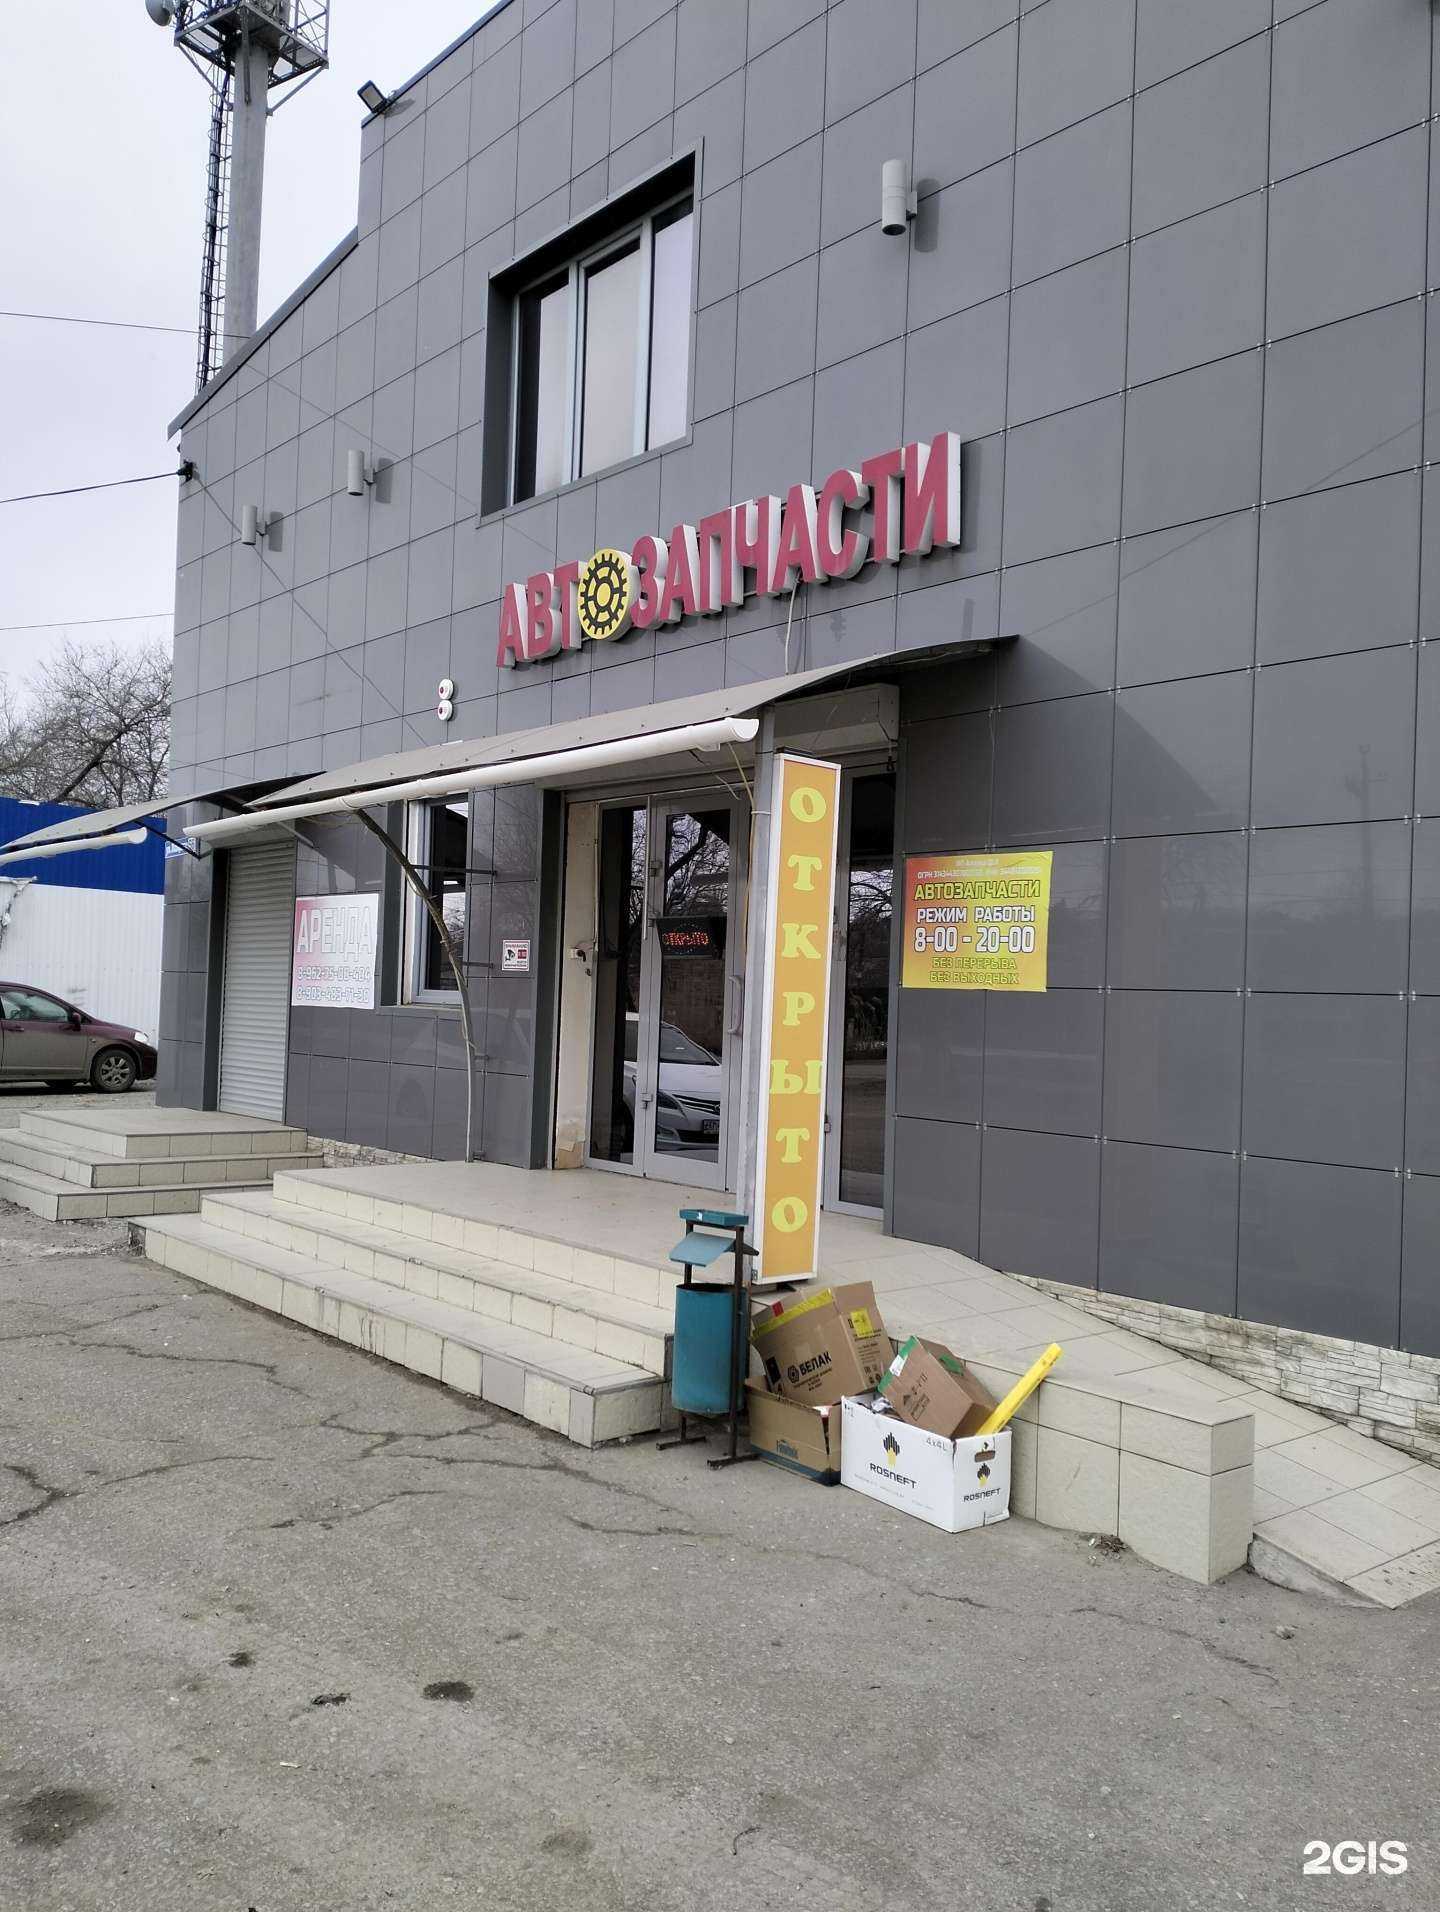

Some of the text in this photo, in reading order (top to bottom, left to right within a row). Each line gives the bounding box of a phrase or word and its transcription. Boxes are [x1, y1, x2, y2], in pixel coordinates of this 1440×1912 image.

[497, 432, 961, 668] АВТОЗАПЧАСТИ
[914, 879, 1041, 900] АВТОЗАПЧАСТИ
[916, 905, 1036, 923] РЕЖИМ РАБОТЫ
[296, 906, 374, 962] АРЕНДА
[914, 926, 958, 953] 8-00
[975, 926, 1036, 953] 20-00
[932, 957, 1017, 970] БЕЗ ПЕРЕРЫВА
[929, 971, 1019, 985] БЕЗ ВЫХОДНЫХ
[769, 787, 826, 1233] ОТКРЫТО
[869, 1462, 918, 1489] ROSNEFT
[963, 1487, 1001, 1503] ROSNEFT
